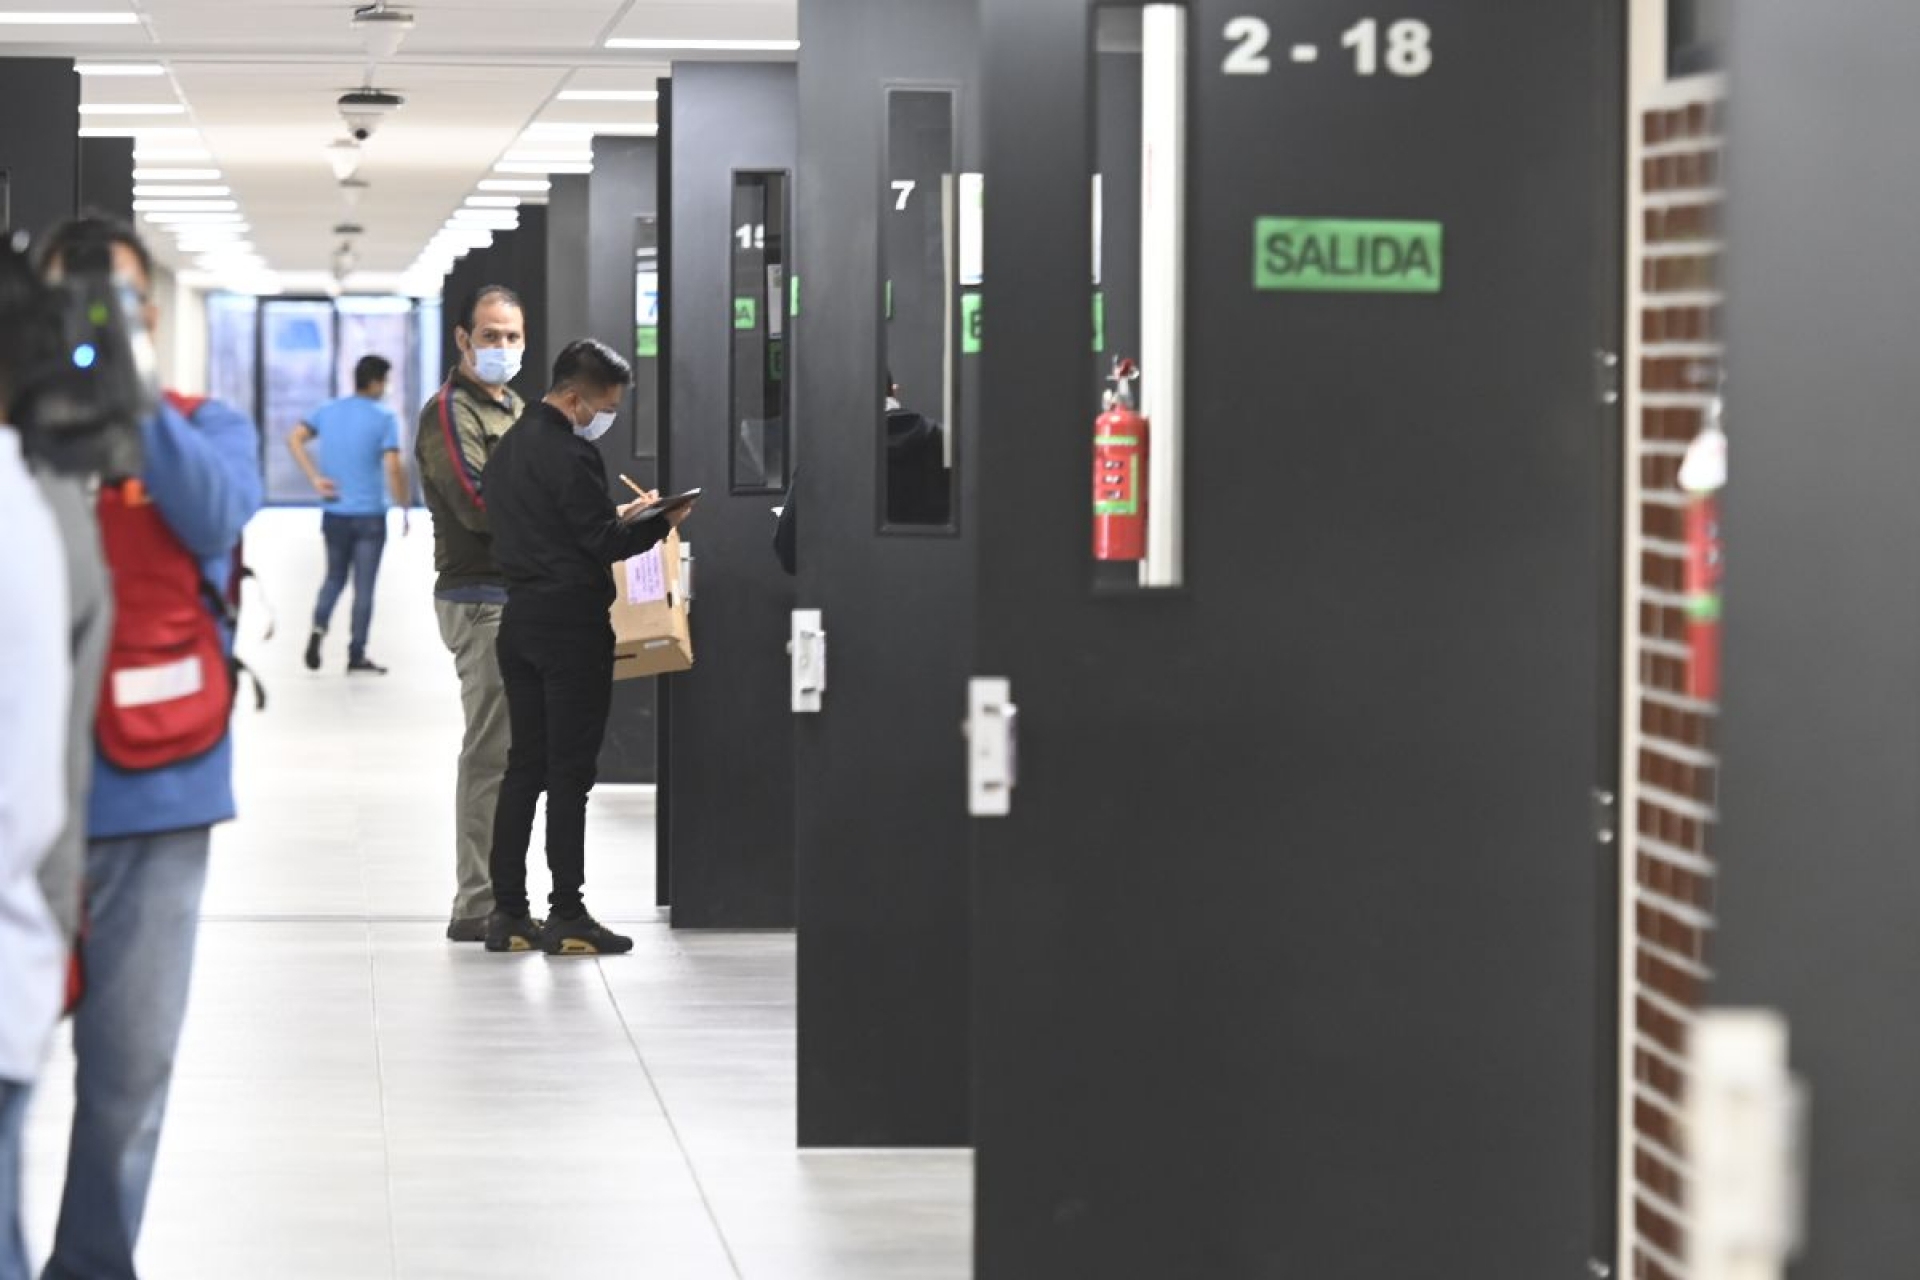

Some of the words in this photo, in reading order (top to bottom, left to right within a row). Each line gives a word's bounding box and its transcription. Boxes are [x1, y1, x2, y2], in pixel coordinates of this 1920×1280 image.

[1222, 15, 1270, 74] 2
[1290, 44, 1318, 62] -
[1341, 18, 1432, 76] 18
[890, 179, 915, 210] 7
[1265, 232, 1433, 278] SALIDA
